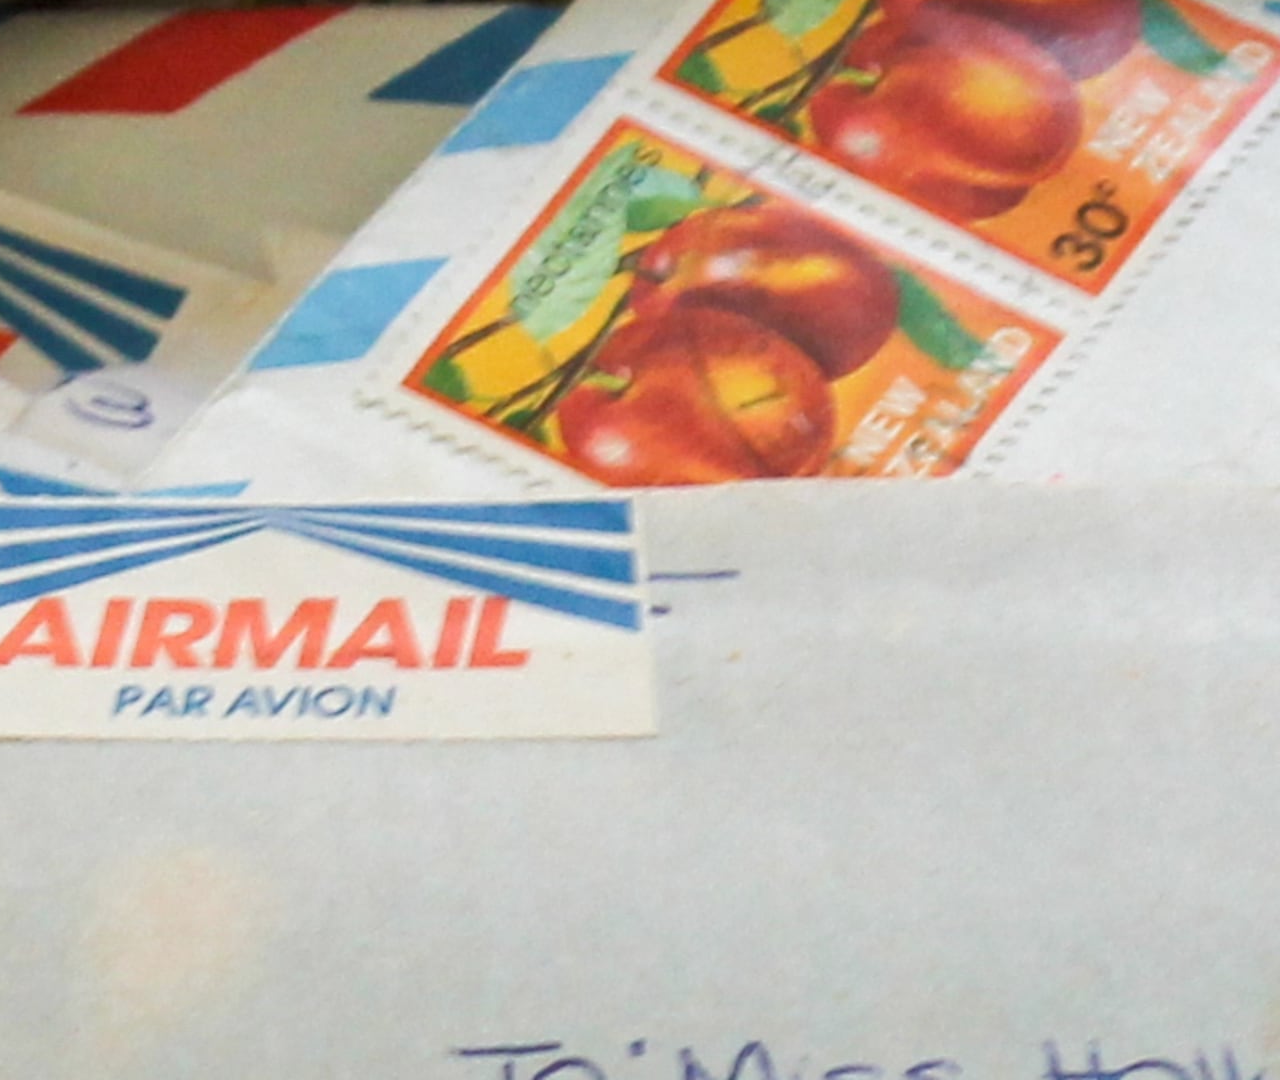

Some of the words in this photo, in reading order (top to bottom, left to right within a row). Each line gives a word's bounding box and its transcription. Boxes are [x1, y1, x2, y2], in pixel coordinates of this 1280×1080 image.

[1086, 75, 1172, 162] NEW
[1128, 38, 1274, 186] ZEALAND
[510, 142, 664, 324] nectarines
[840, 373, 928, 466] NEW
[111, 684, 210, 719] PAR
[222, 684, 399, 719] AVION
